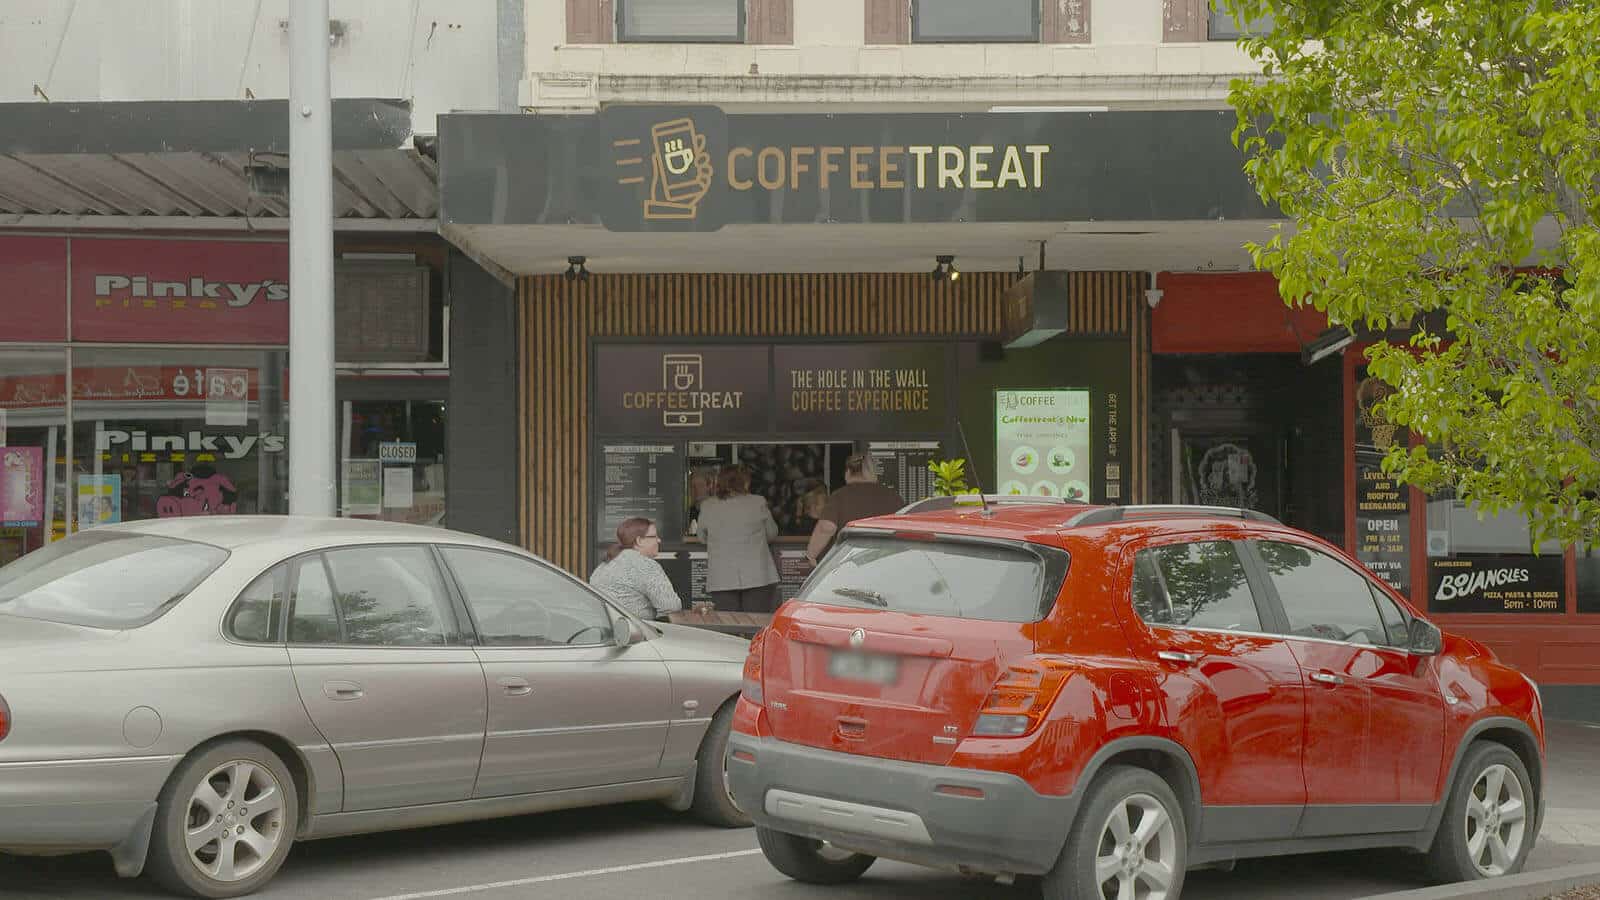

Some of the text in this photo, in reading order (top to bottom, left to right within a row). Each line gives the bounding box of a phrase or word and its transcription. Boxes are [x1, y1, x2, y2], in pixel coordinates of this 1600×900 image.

[727, 144, 1050, 190] COFFEETREAT
[95, 275, 289, 307] Pinky's
[792, 370, 929, 388] THE HOLE IN THE WALL
[623, 391, 744, 409] COFFEETREAT
[792, 390, 929, 411] COFFEE EXPERIENCE
[1020, 396, 1056, 406] COFFEE
[1066, 415, 1087, 424] New
[95, 430, 286, 459] Pinky's
[381, 446, 416, 458] CLOSED
[1363, 471, 1385, 480] LEVEL
[1375, 482, 1391, 490] AND
[1366, 492, 1400, 501] ROOFTOP
[1359, 502, 1407, 511] BEERGARDEN
[1367, 519, 1400, 532] OPEN
[1389, 561, 1402, 570] VIA
[1434, 568, 1529, 601] BOJANGLES
[1504, 591, 1525, 599] PASTA
